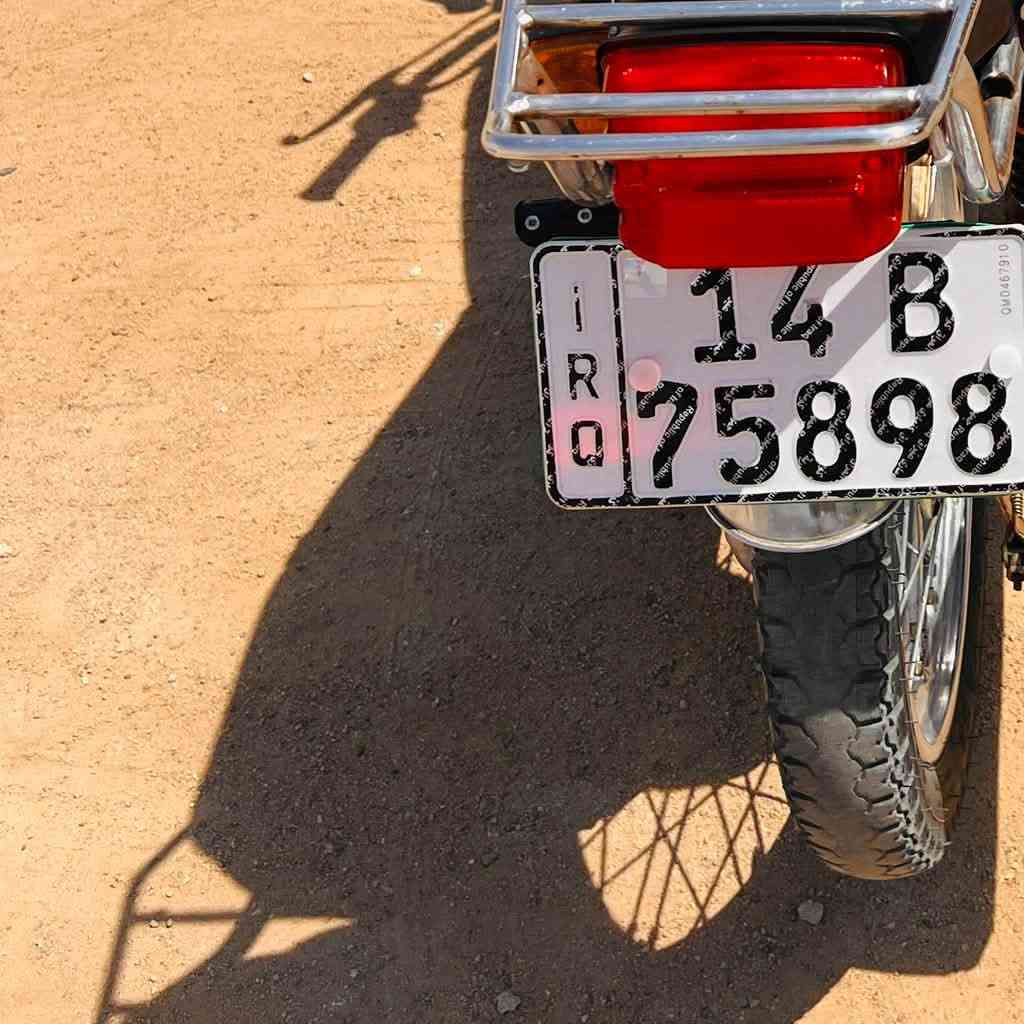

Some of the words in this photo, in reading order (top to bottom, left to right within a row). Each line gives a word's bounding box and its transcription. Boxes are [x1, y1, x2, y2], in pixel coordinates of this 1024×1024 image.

[689, 265, 834, 363] 14
[888, 251, 956, 353] B
[635, 371, 1013, 489] 75898
